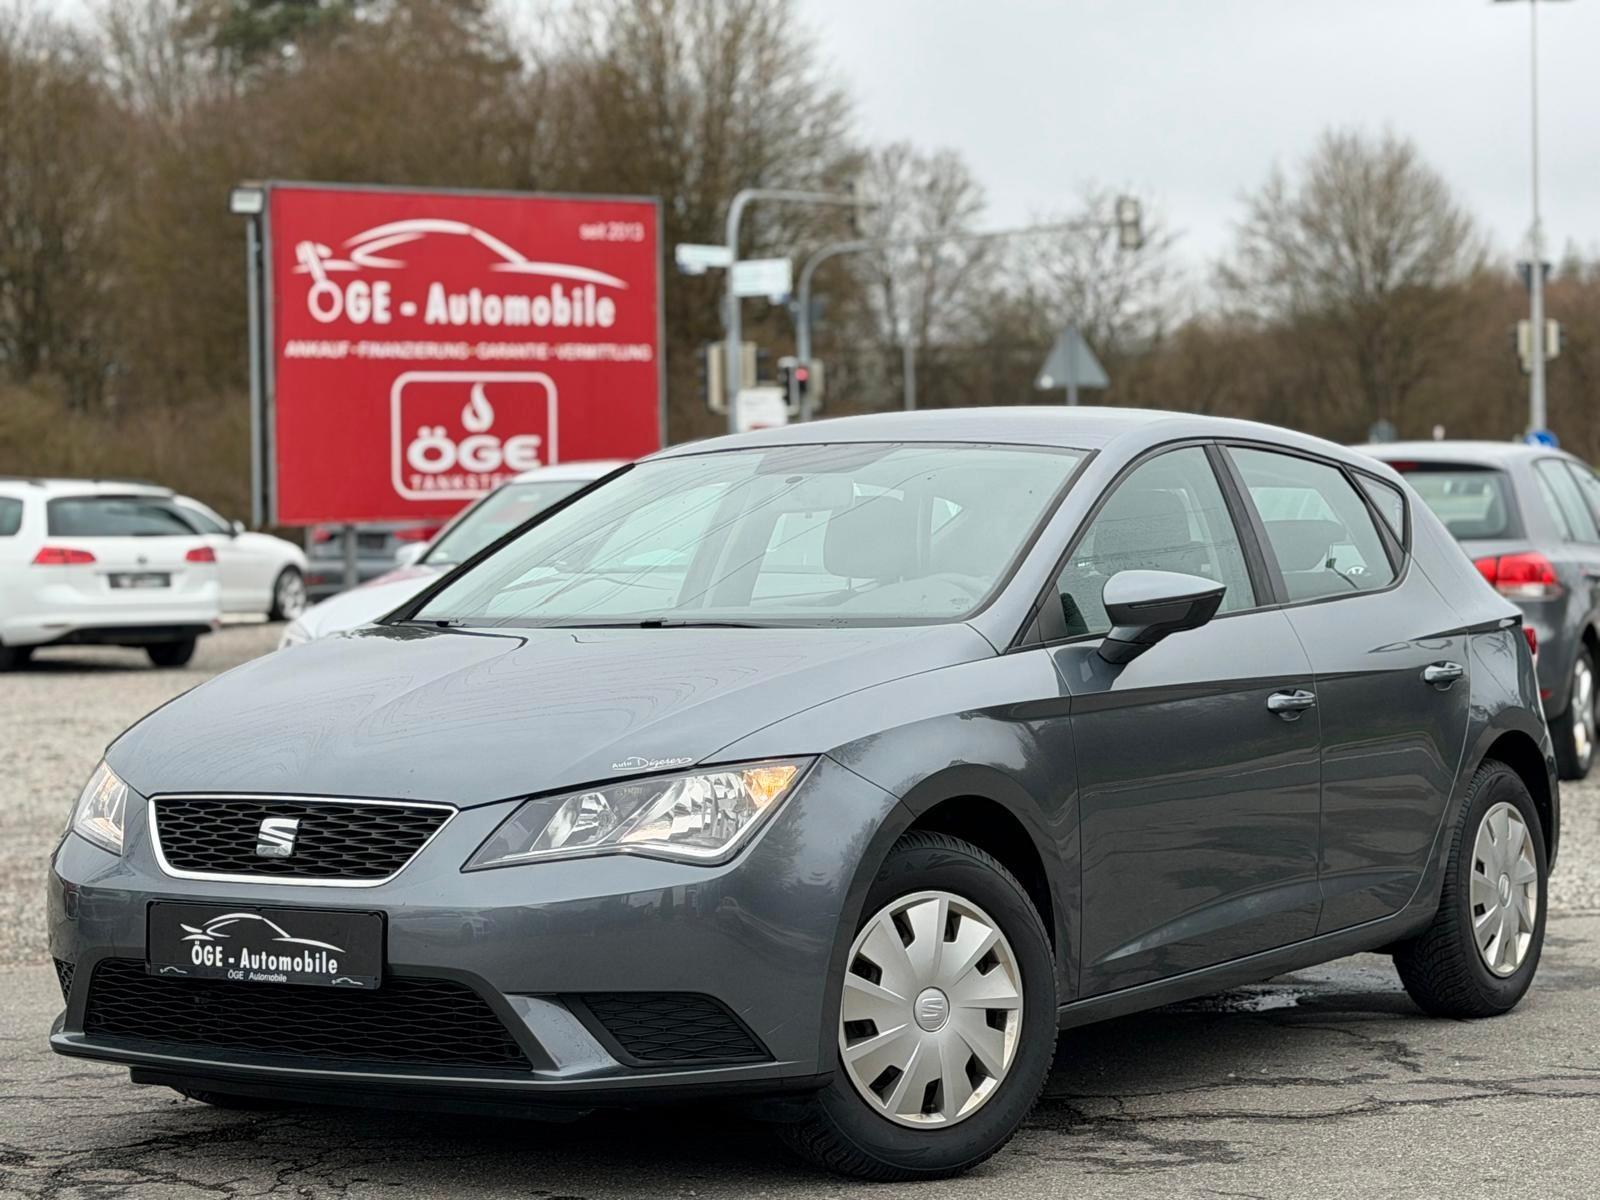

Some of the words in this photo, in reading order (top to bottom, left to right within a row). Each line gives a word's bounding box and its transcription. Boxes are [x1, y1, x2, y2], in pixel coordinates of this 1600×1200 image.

[424, 281, 616, 327] Automobile
[407, 425, 542, 473] ÖGE
[191, 940, 223, 966] ÖGE
[240, 948, 338, 974] Automobile
[248, 972, 287, 982] Automobile
